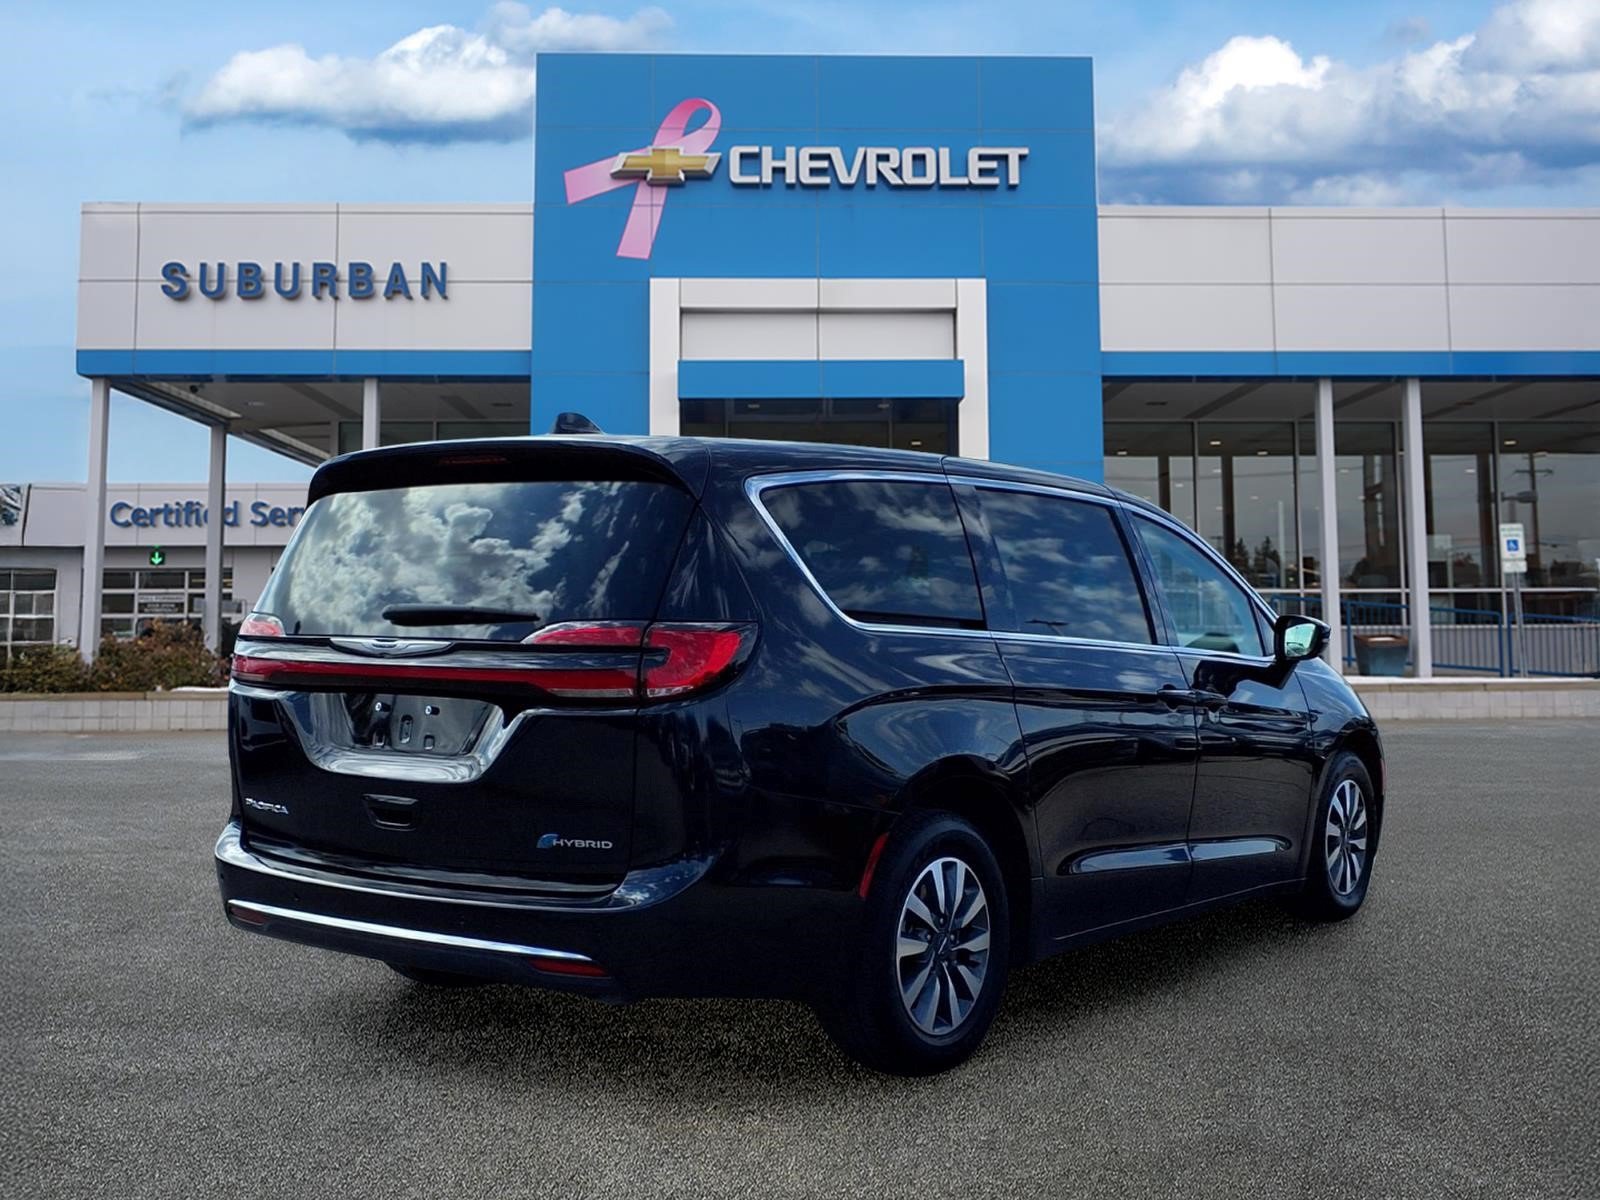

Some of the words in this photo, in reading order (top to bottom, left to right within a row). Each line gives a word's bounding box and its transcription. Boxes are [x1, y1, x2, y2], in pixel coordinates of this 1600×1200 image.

[729, 145, 1029, 186] CHEVROLET
[161, 261, 449, 300] SUBURBAN
[552, 838, 613, 849] HYBRID
